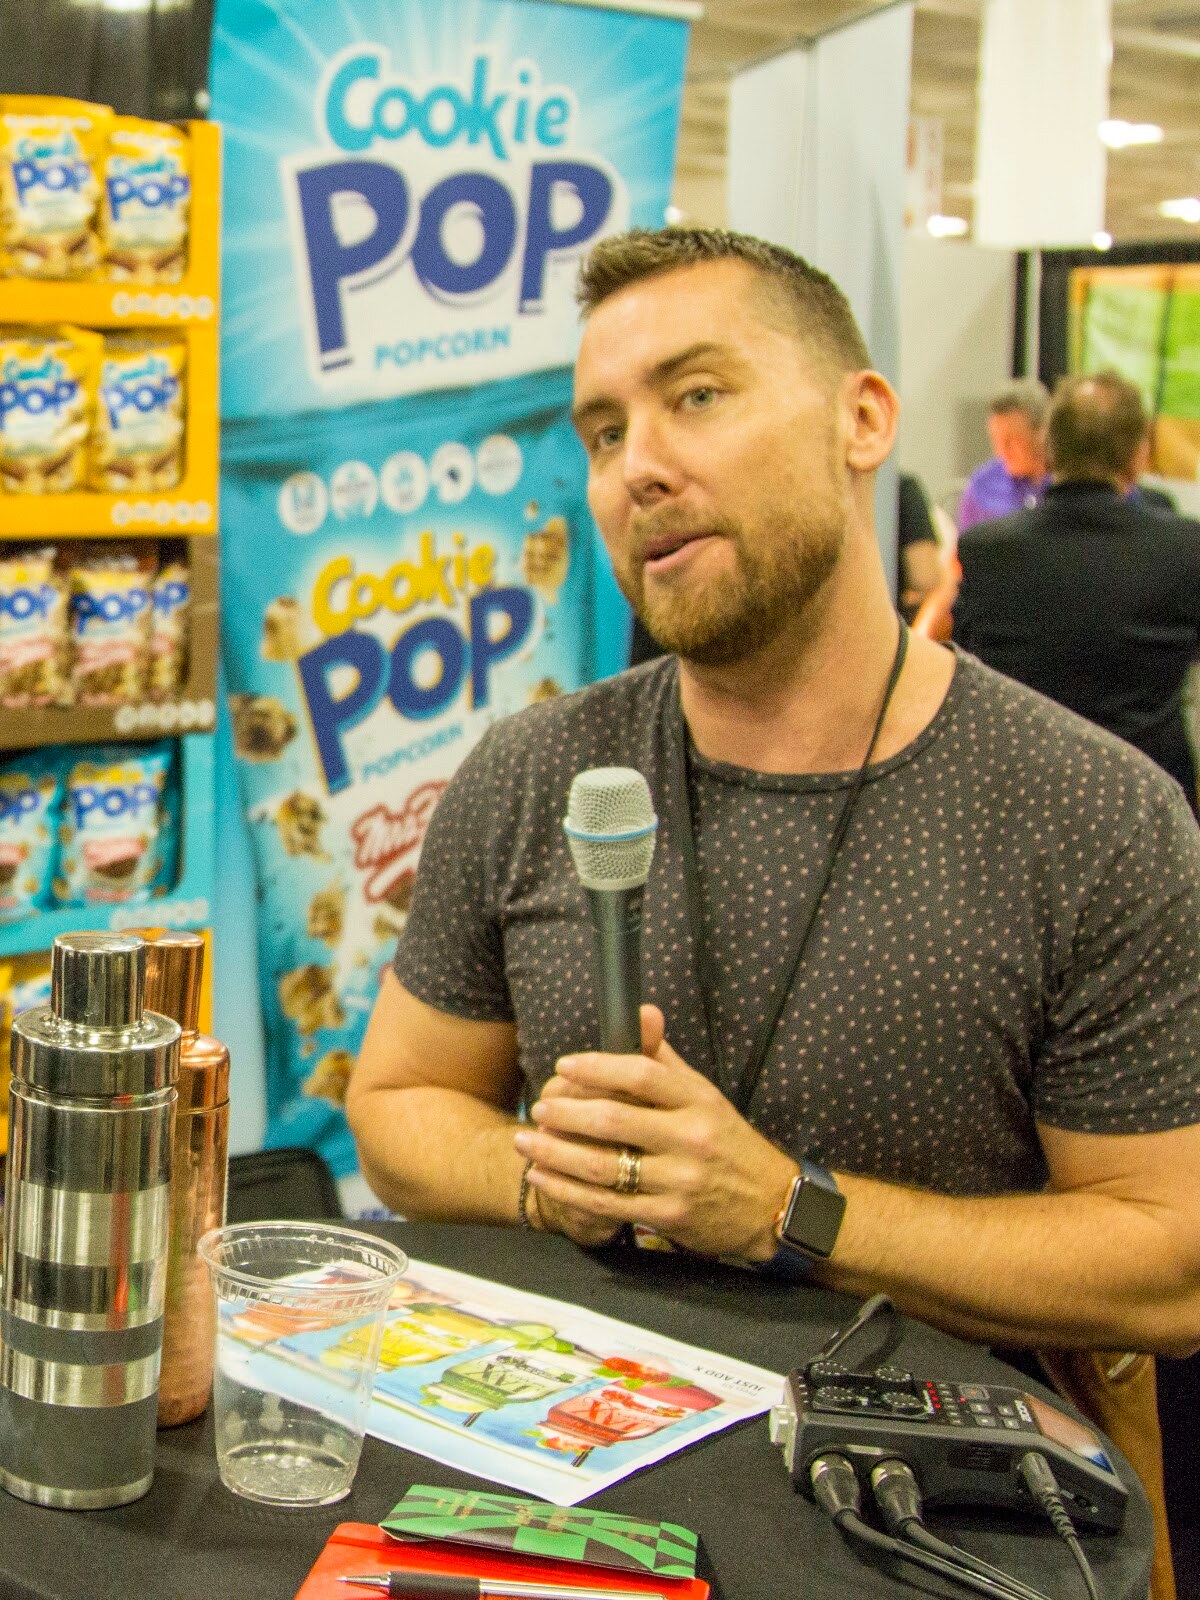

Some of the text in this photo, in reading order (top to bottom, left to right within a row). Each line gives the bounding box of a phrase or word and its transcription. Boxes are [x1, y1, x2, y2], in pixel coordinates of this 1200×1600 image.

[325, 53, 571, 160] Cookie
[12, 161, 91, 209] POP
[106, 176, 191, 222] POP
[296, 158, 615, 364] POP
[373, 325, 513, 370] POPCORN
[311, 530, 498, 637] Cookie
[72, 588, 149, 635] POP
[298, 585, 537, 794] POP
[72, 784, 158, 831] POP
[704, 1369, 736, 1383] ADD
[734, 1378, 767, 1392] JUST
